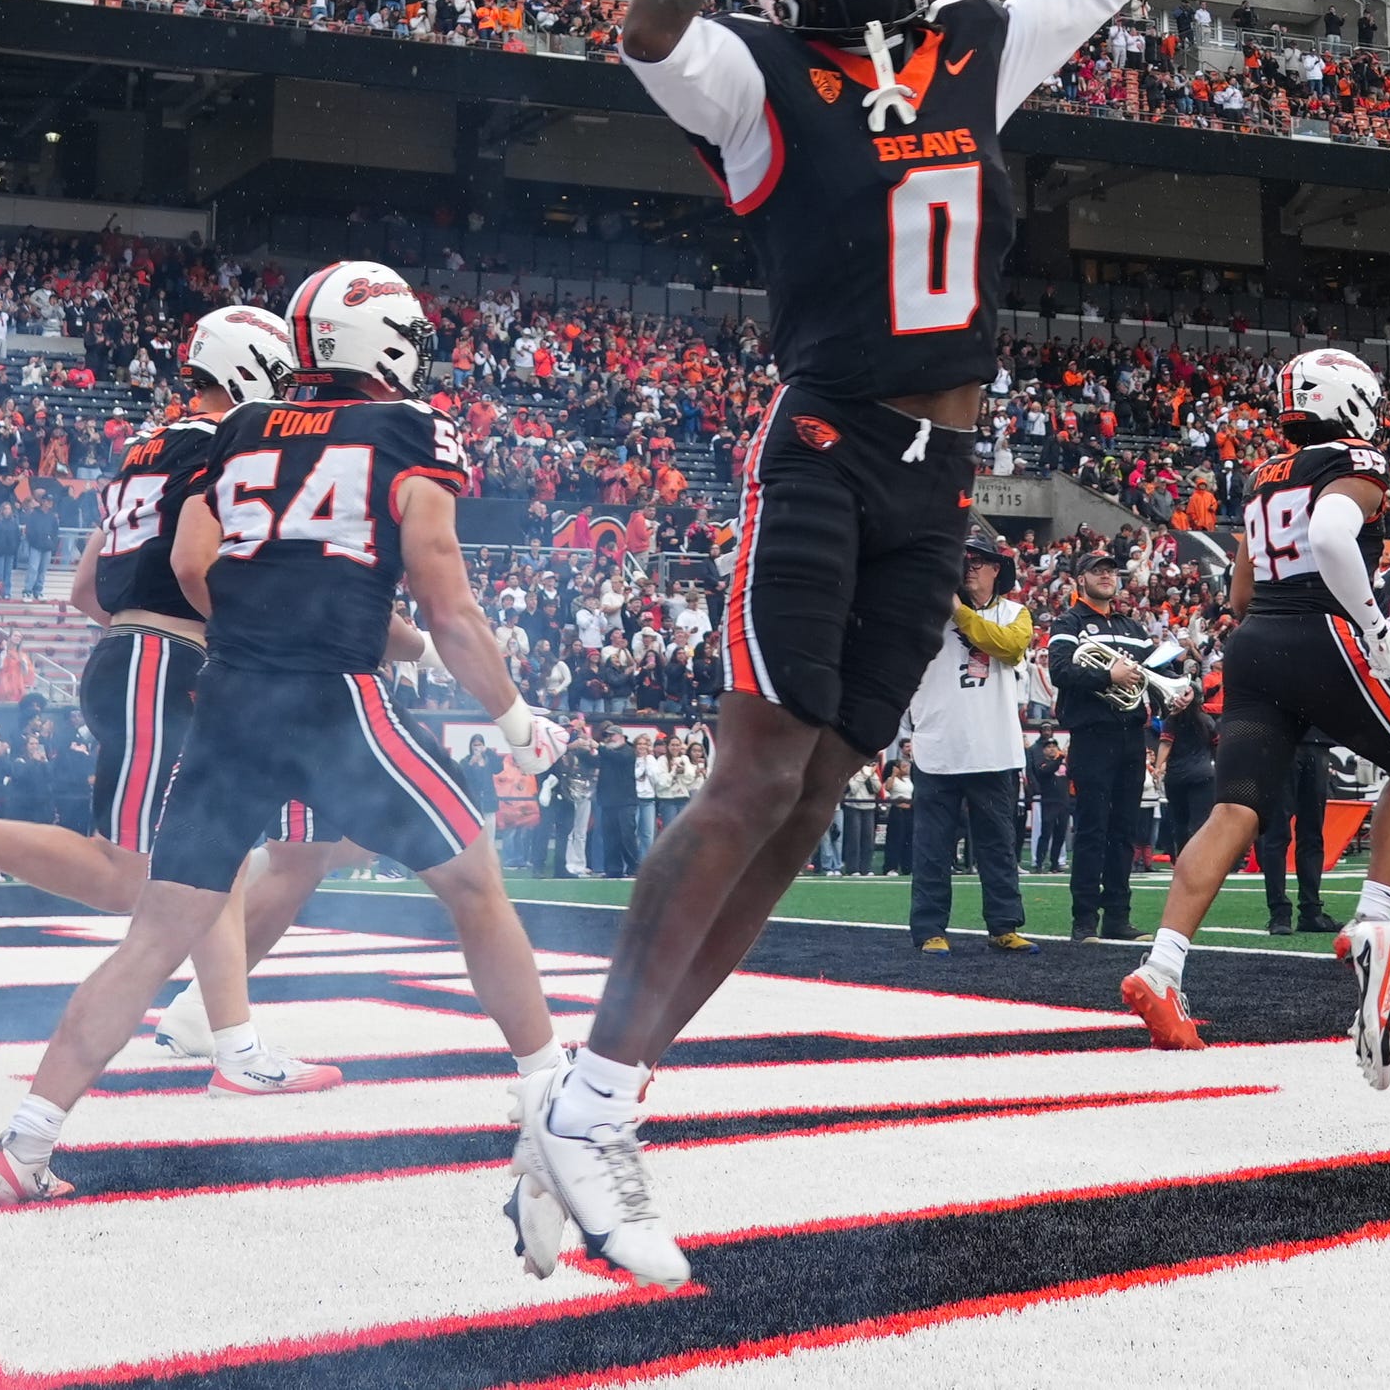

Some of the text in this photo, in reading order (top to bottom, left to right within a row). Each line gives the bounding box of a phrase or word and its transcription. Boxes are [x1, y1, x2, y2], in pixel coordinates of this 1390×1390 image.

[873, 128, 977, 162] BEAVS
[888, 161, 982, 336] 0
[262, 408, 337, 438] POND
[214, 443, 378, 566] 54
[974, 492, 1022, 506] 14 115
